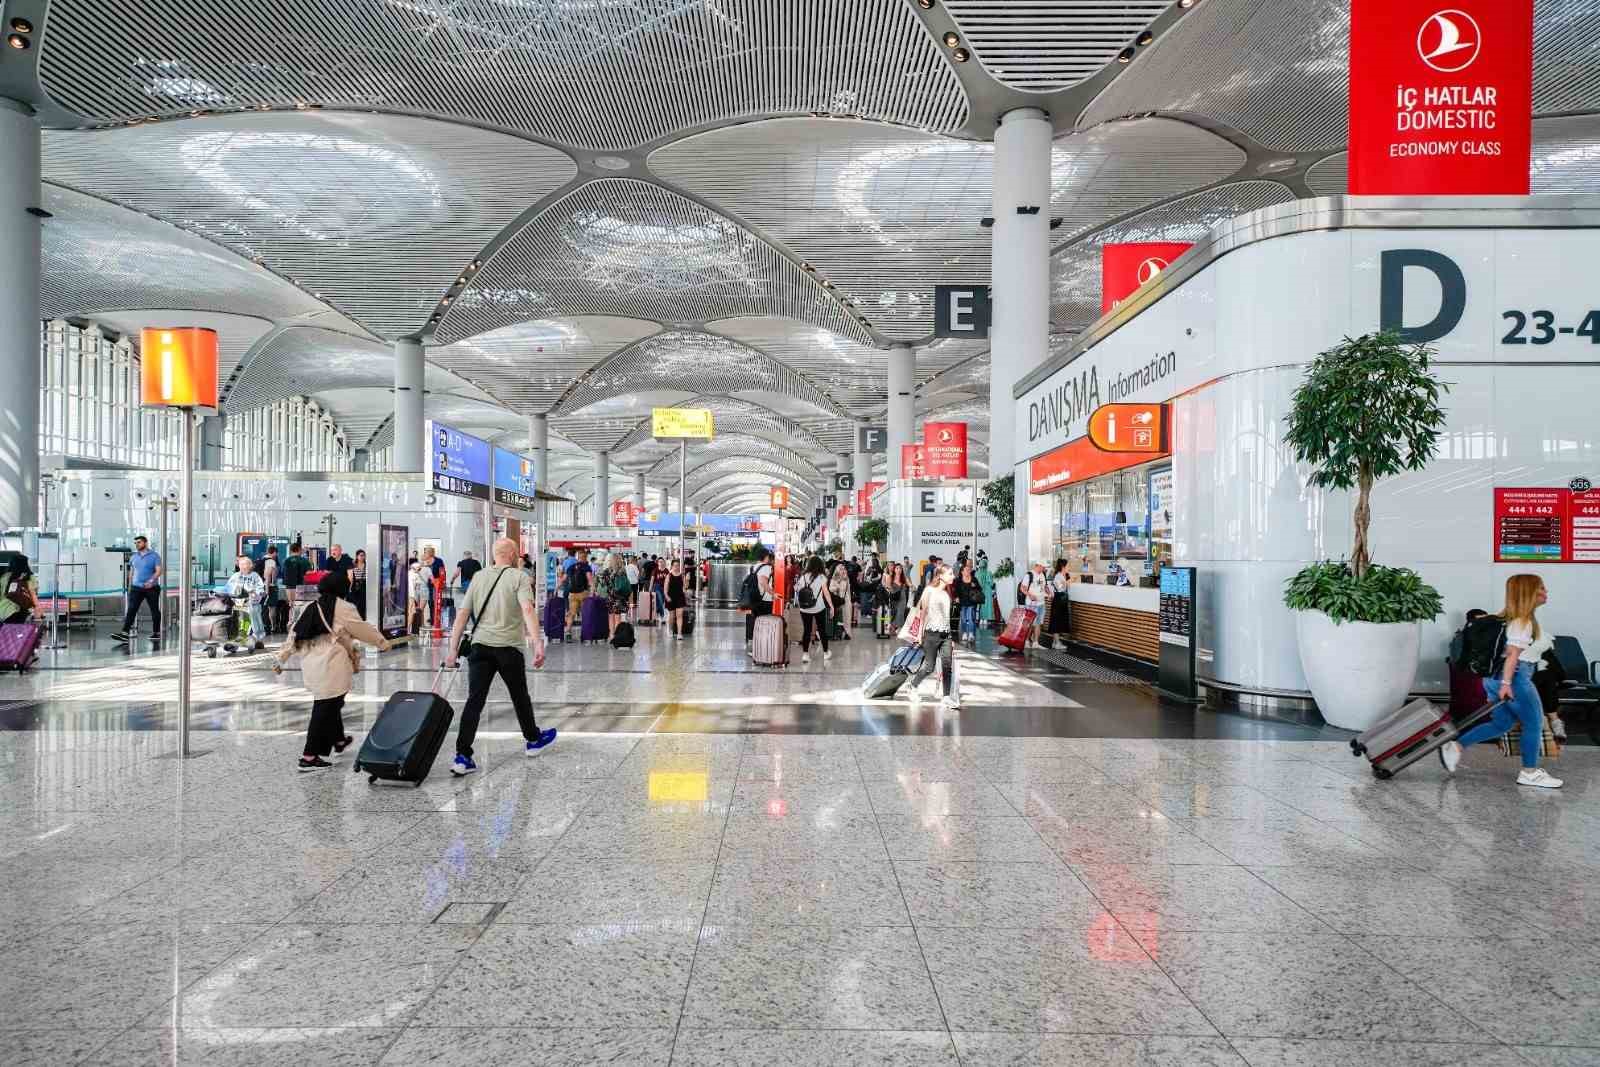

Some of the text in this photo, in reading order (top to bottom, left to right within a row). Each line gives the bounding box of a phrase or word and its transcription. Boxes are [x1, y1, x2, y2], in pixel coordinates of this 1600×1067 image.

[1397, 84, 1497, 111] İÇ HATLAR
[1397, 110, 1496, 131] DOMESTIC
[1390, 141, 1501, 157] ECONOMY CLASS
[1381, 249, 1467, 344] D
[950, 291, 975, 331] E
[1029, 351, 1176, 442] DANIŞMA Information
[866, 430, 880, 450] F
[838, 475, 850, 488] G
[1572, 481, 1590, 489] SOS
[921, 491, 973, 513] E 22-43
